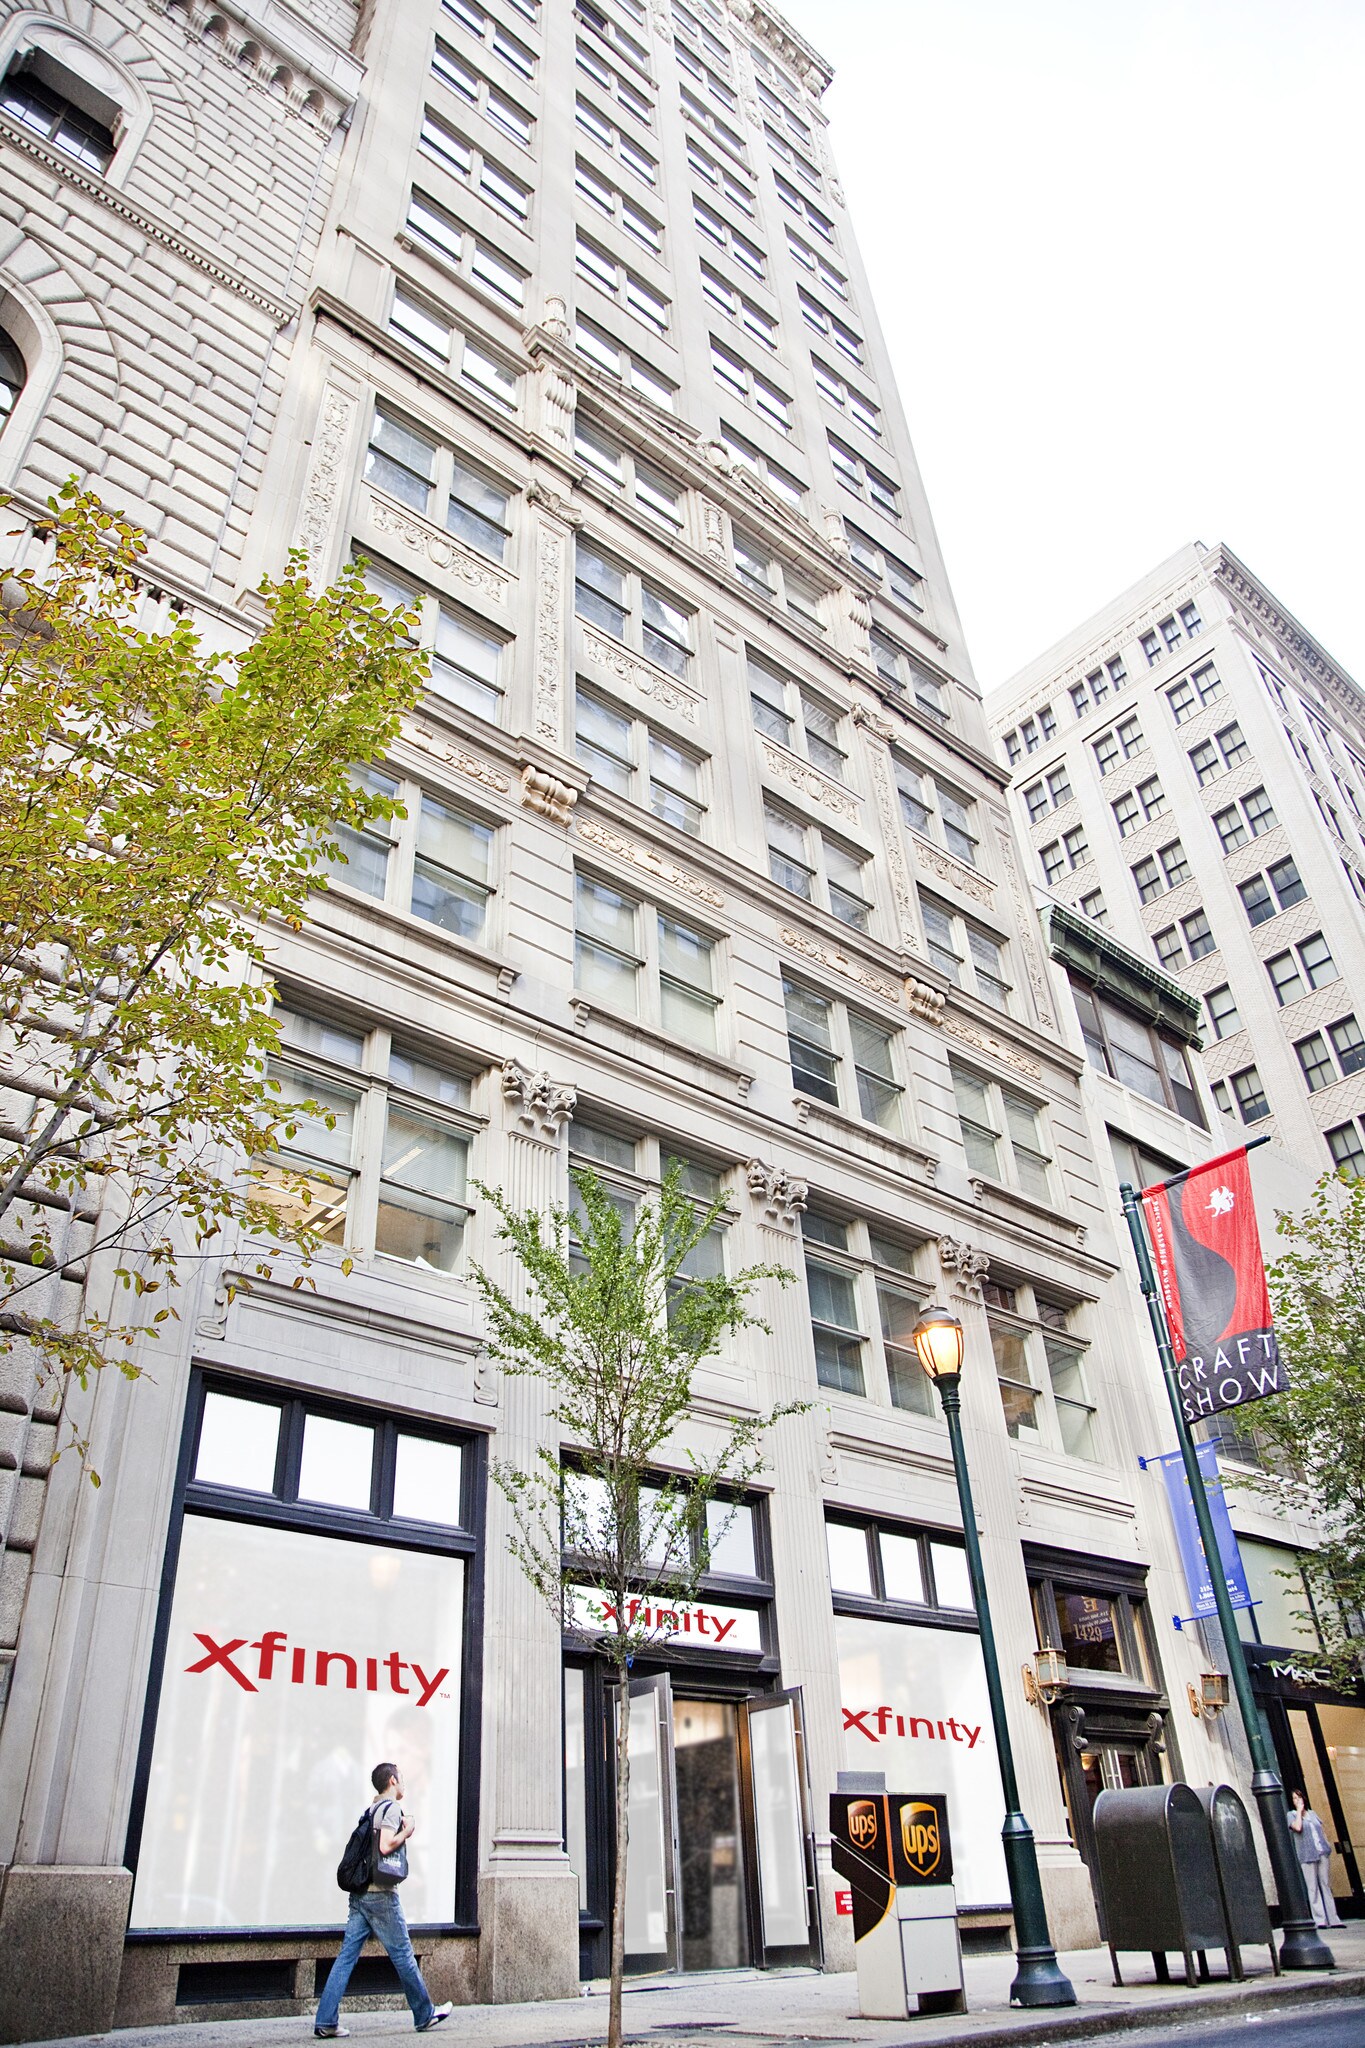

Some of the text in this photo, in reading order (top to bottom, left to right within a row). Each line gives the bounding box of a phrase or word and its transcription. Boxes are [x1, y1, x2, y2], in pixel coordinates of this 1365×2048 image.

[1178, 1334, 1271, 1390] CRAFT
[1182, 1365, 1278, 1421] SHOW
[601, 1599, 736, 1642] xfinity
[1073, 1623, 1103, 1643] 1429
[183, 1631, 450, 1707] xfinity
[841, 1706, 981, 1748] xfinity
[850, 1814, 875, 1842] ups
[904, 1825, 938, 1865] ups
